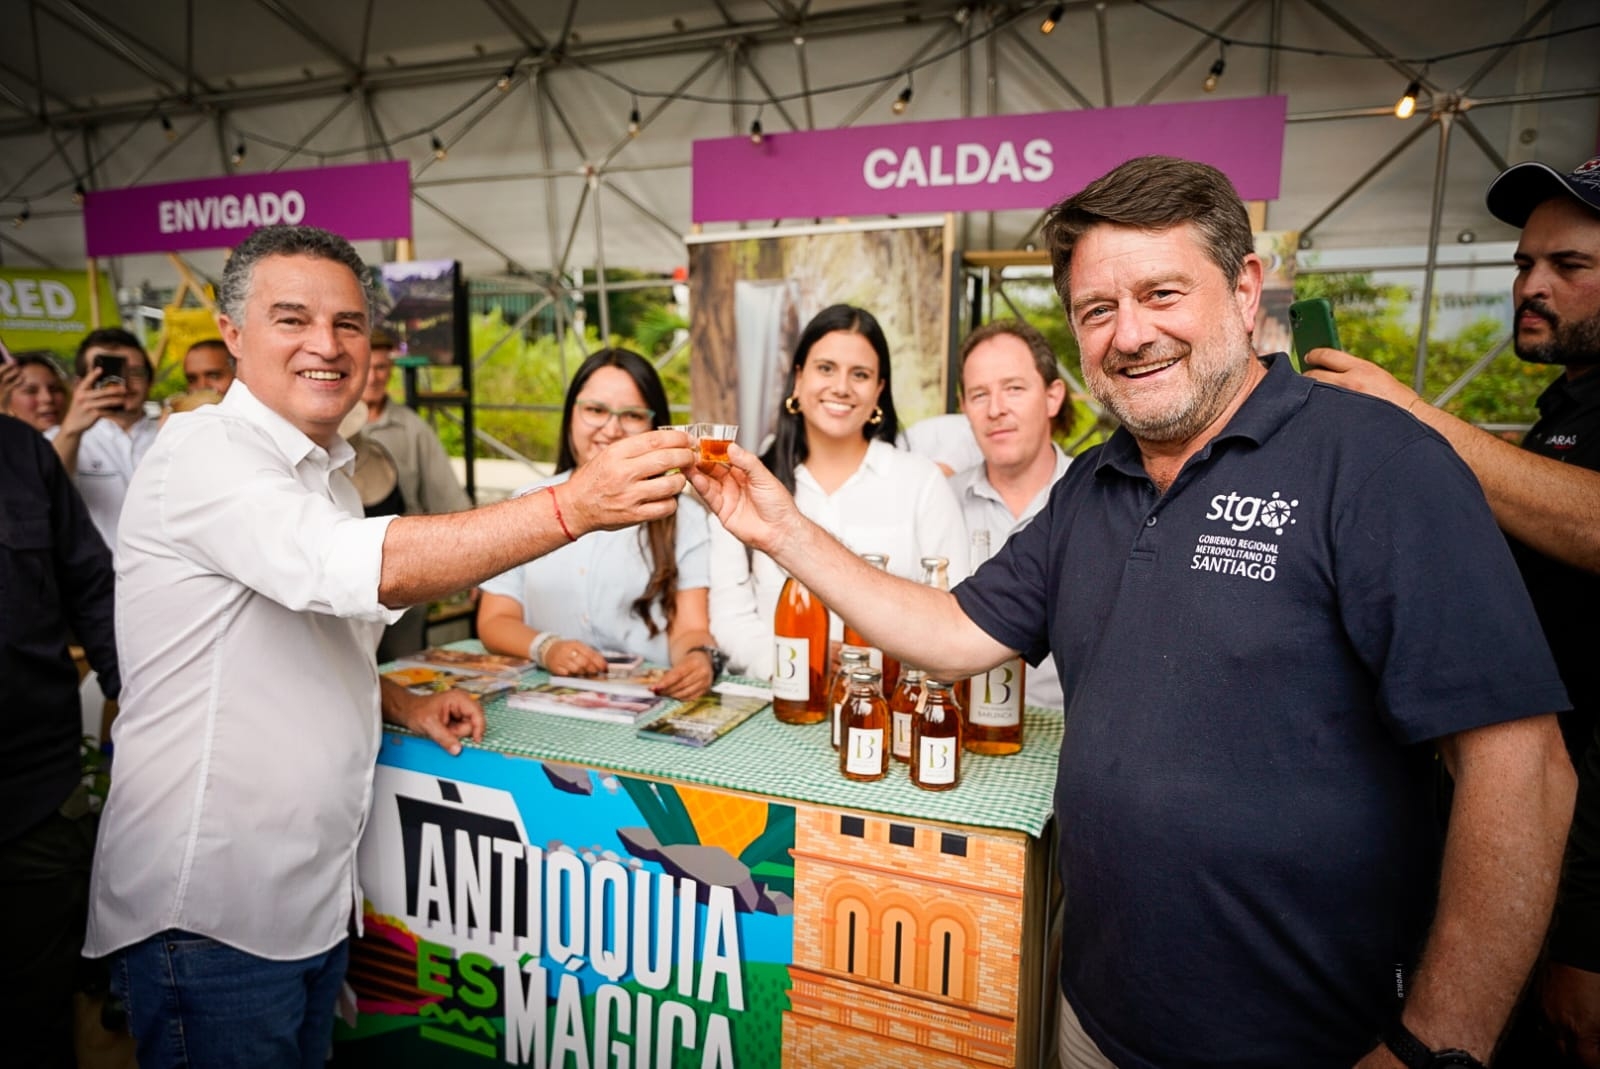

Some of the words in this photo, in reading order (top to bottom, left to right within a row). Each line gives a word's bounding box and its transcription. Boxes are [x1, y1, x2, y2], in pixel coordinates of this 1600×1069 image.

[863, 139, 1054, 190] CALDAS
[158, 189, 305, 234] ENVIGADO
[1195, 544, 1263, 562] METROPOLITANO
[1264, 554, 1278, 565] DE
[1198, 534, 1237, 547] GOBIERNO
[1237, 538, 1280, 555] REGIONAL
[1190, 554, 1277, 582] SANTIAGO
[415, 822, 745, 1012] ANTIOQUIA
[416, 938, 498, 1010] ES
